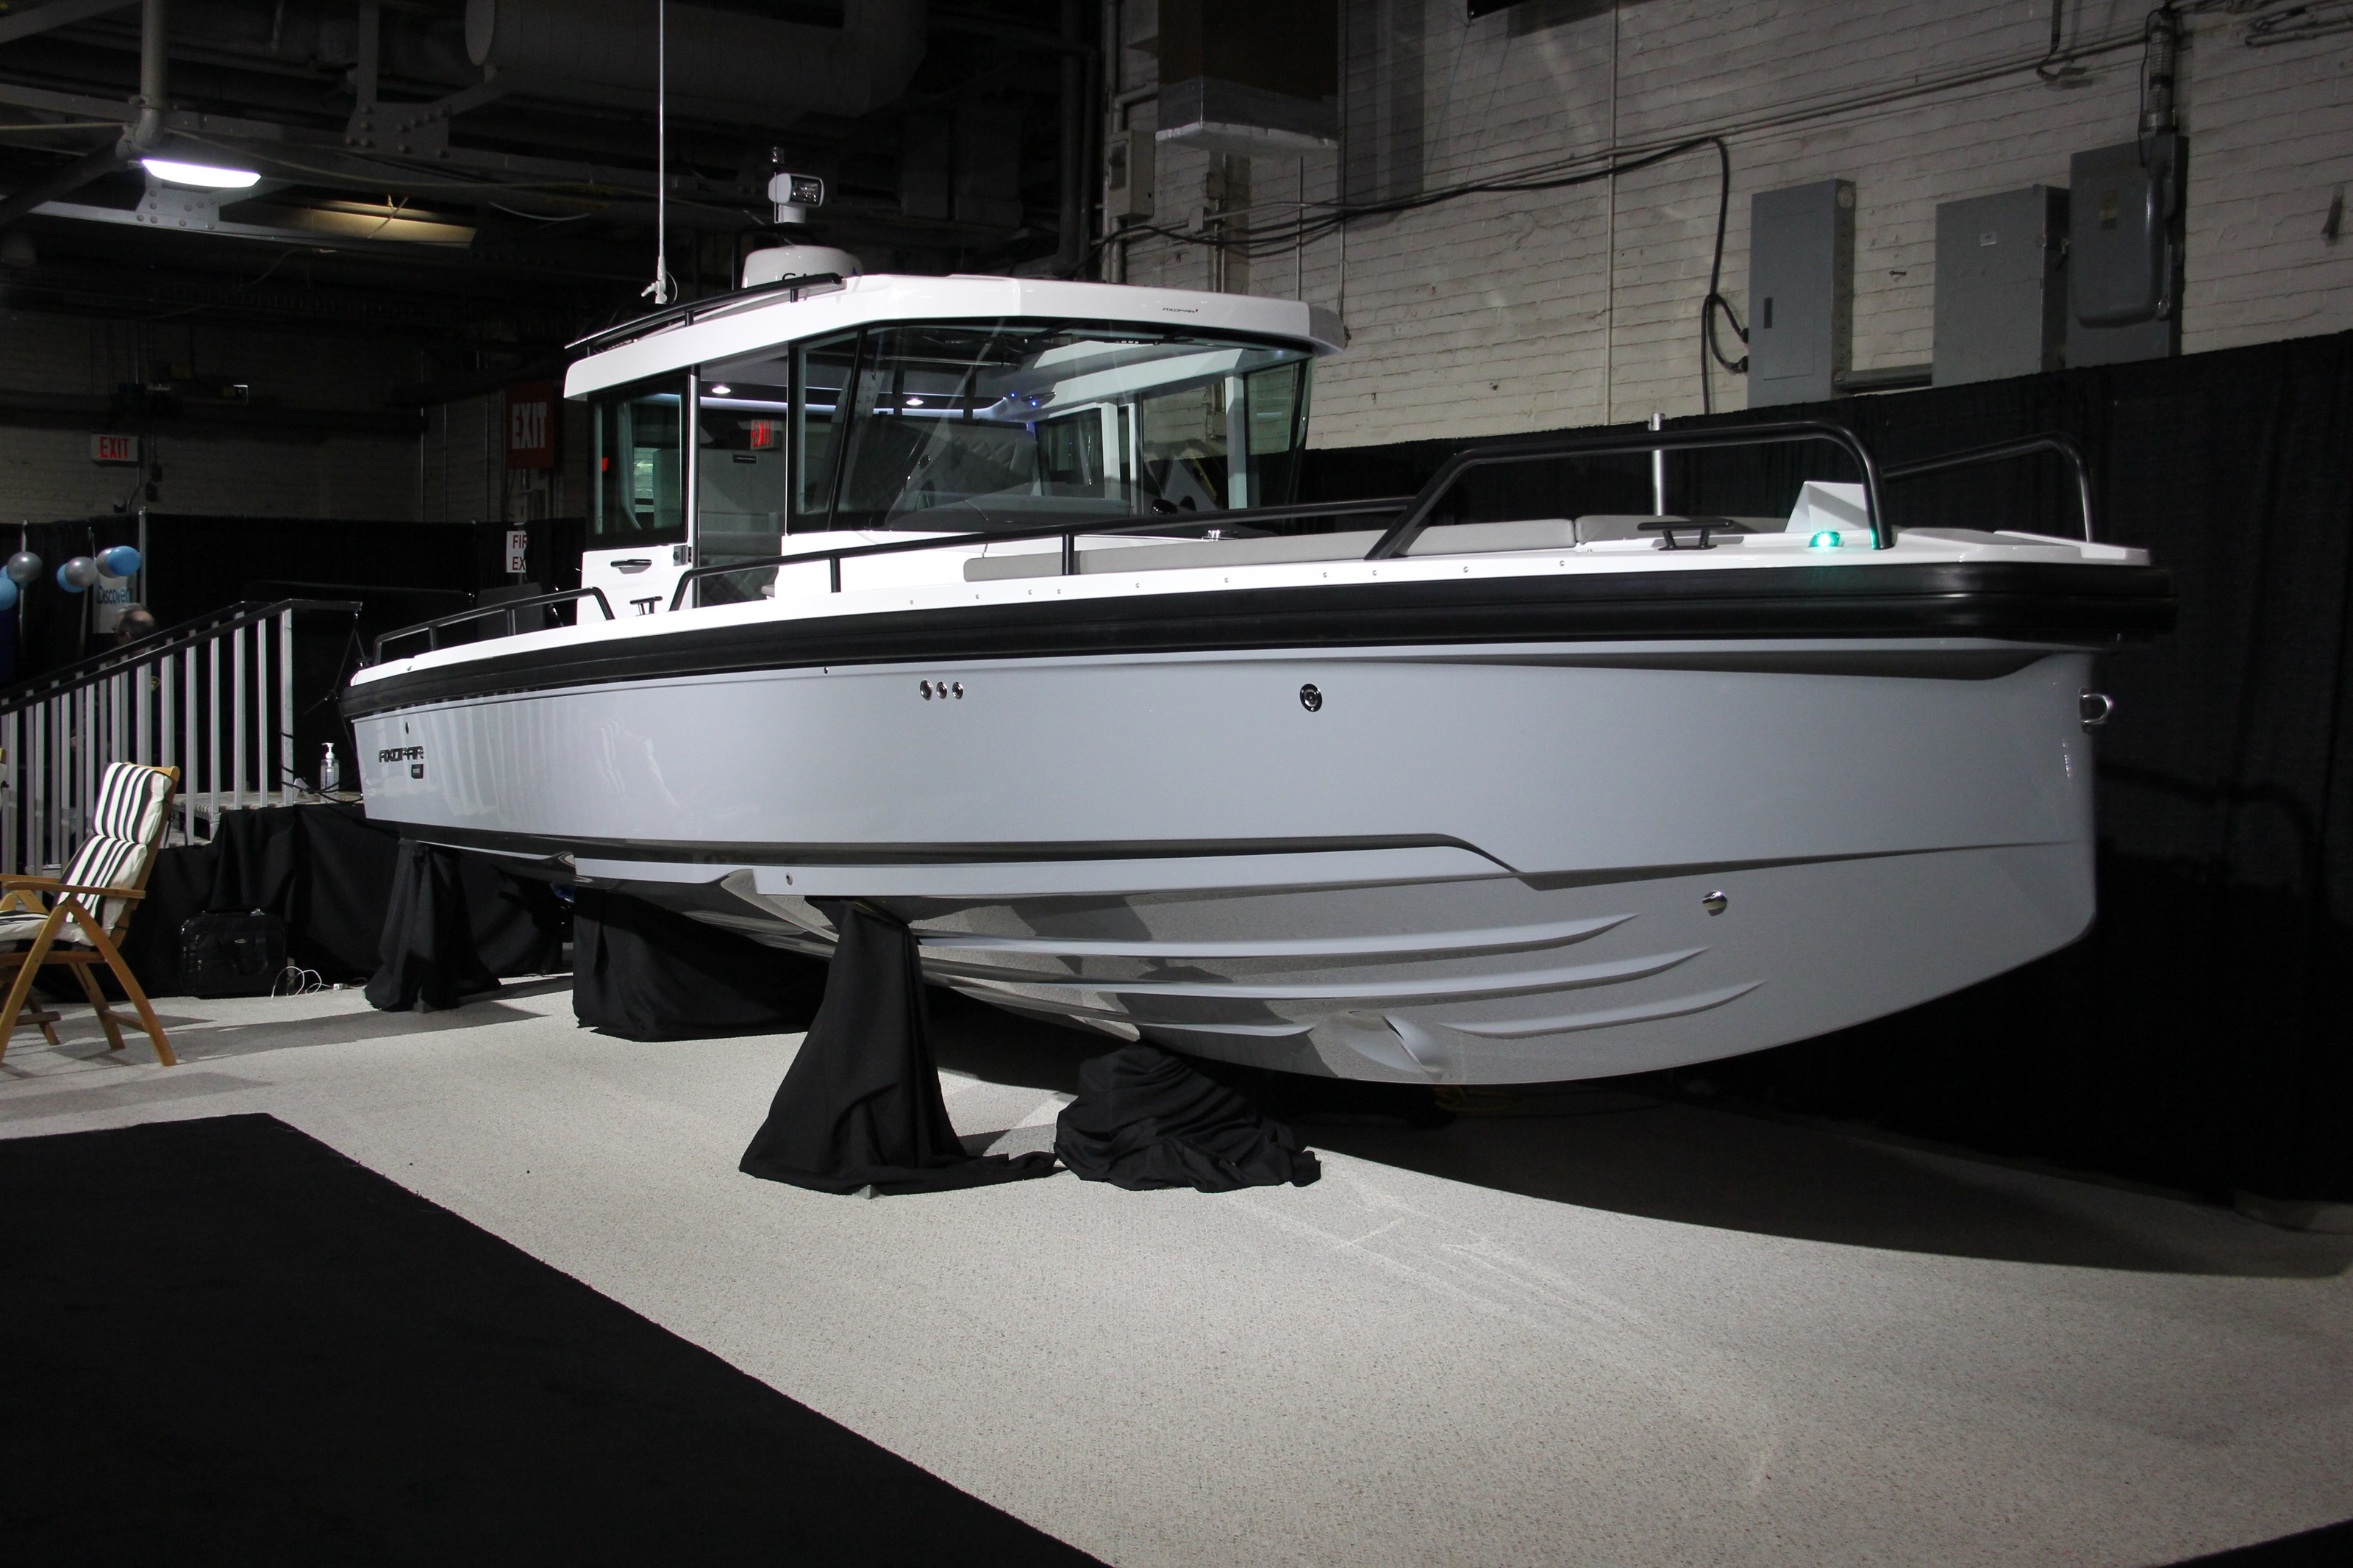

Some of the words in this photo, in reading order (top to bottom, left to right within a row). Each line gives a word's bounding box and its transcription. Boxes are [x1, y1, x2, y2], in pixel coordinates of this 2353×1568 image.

[512, 402, 547, 449] EXIT
[752, 418, 772, 448] EXIT
[100, 437, 129, 459] EXIT
[512, 556, 526, 570] EX
[379, 746, 424, 762] AXOPAR
